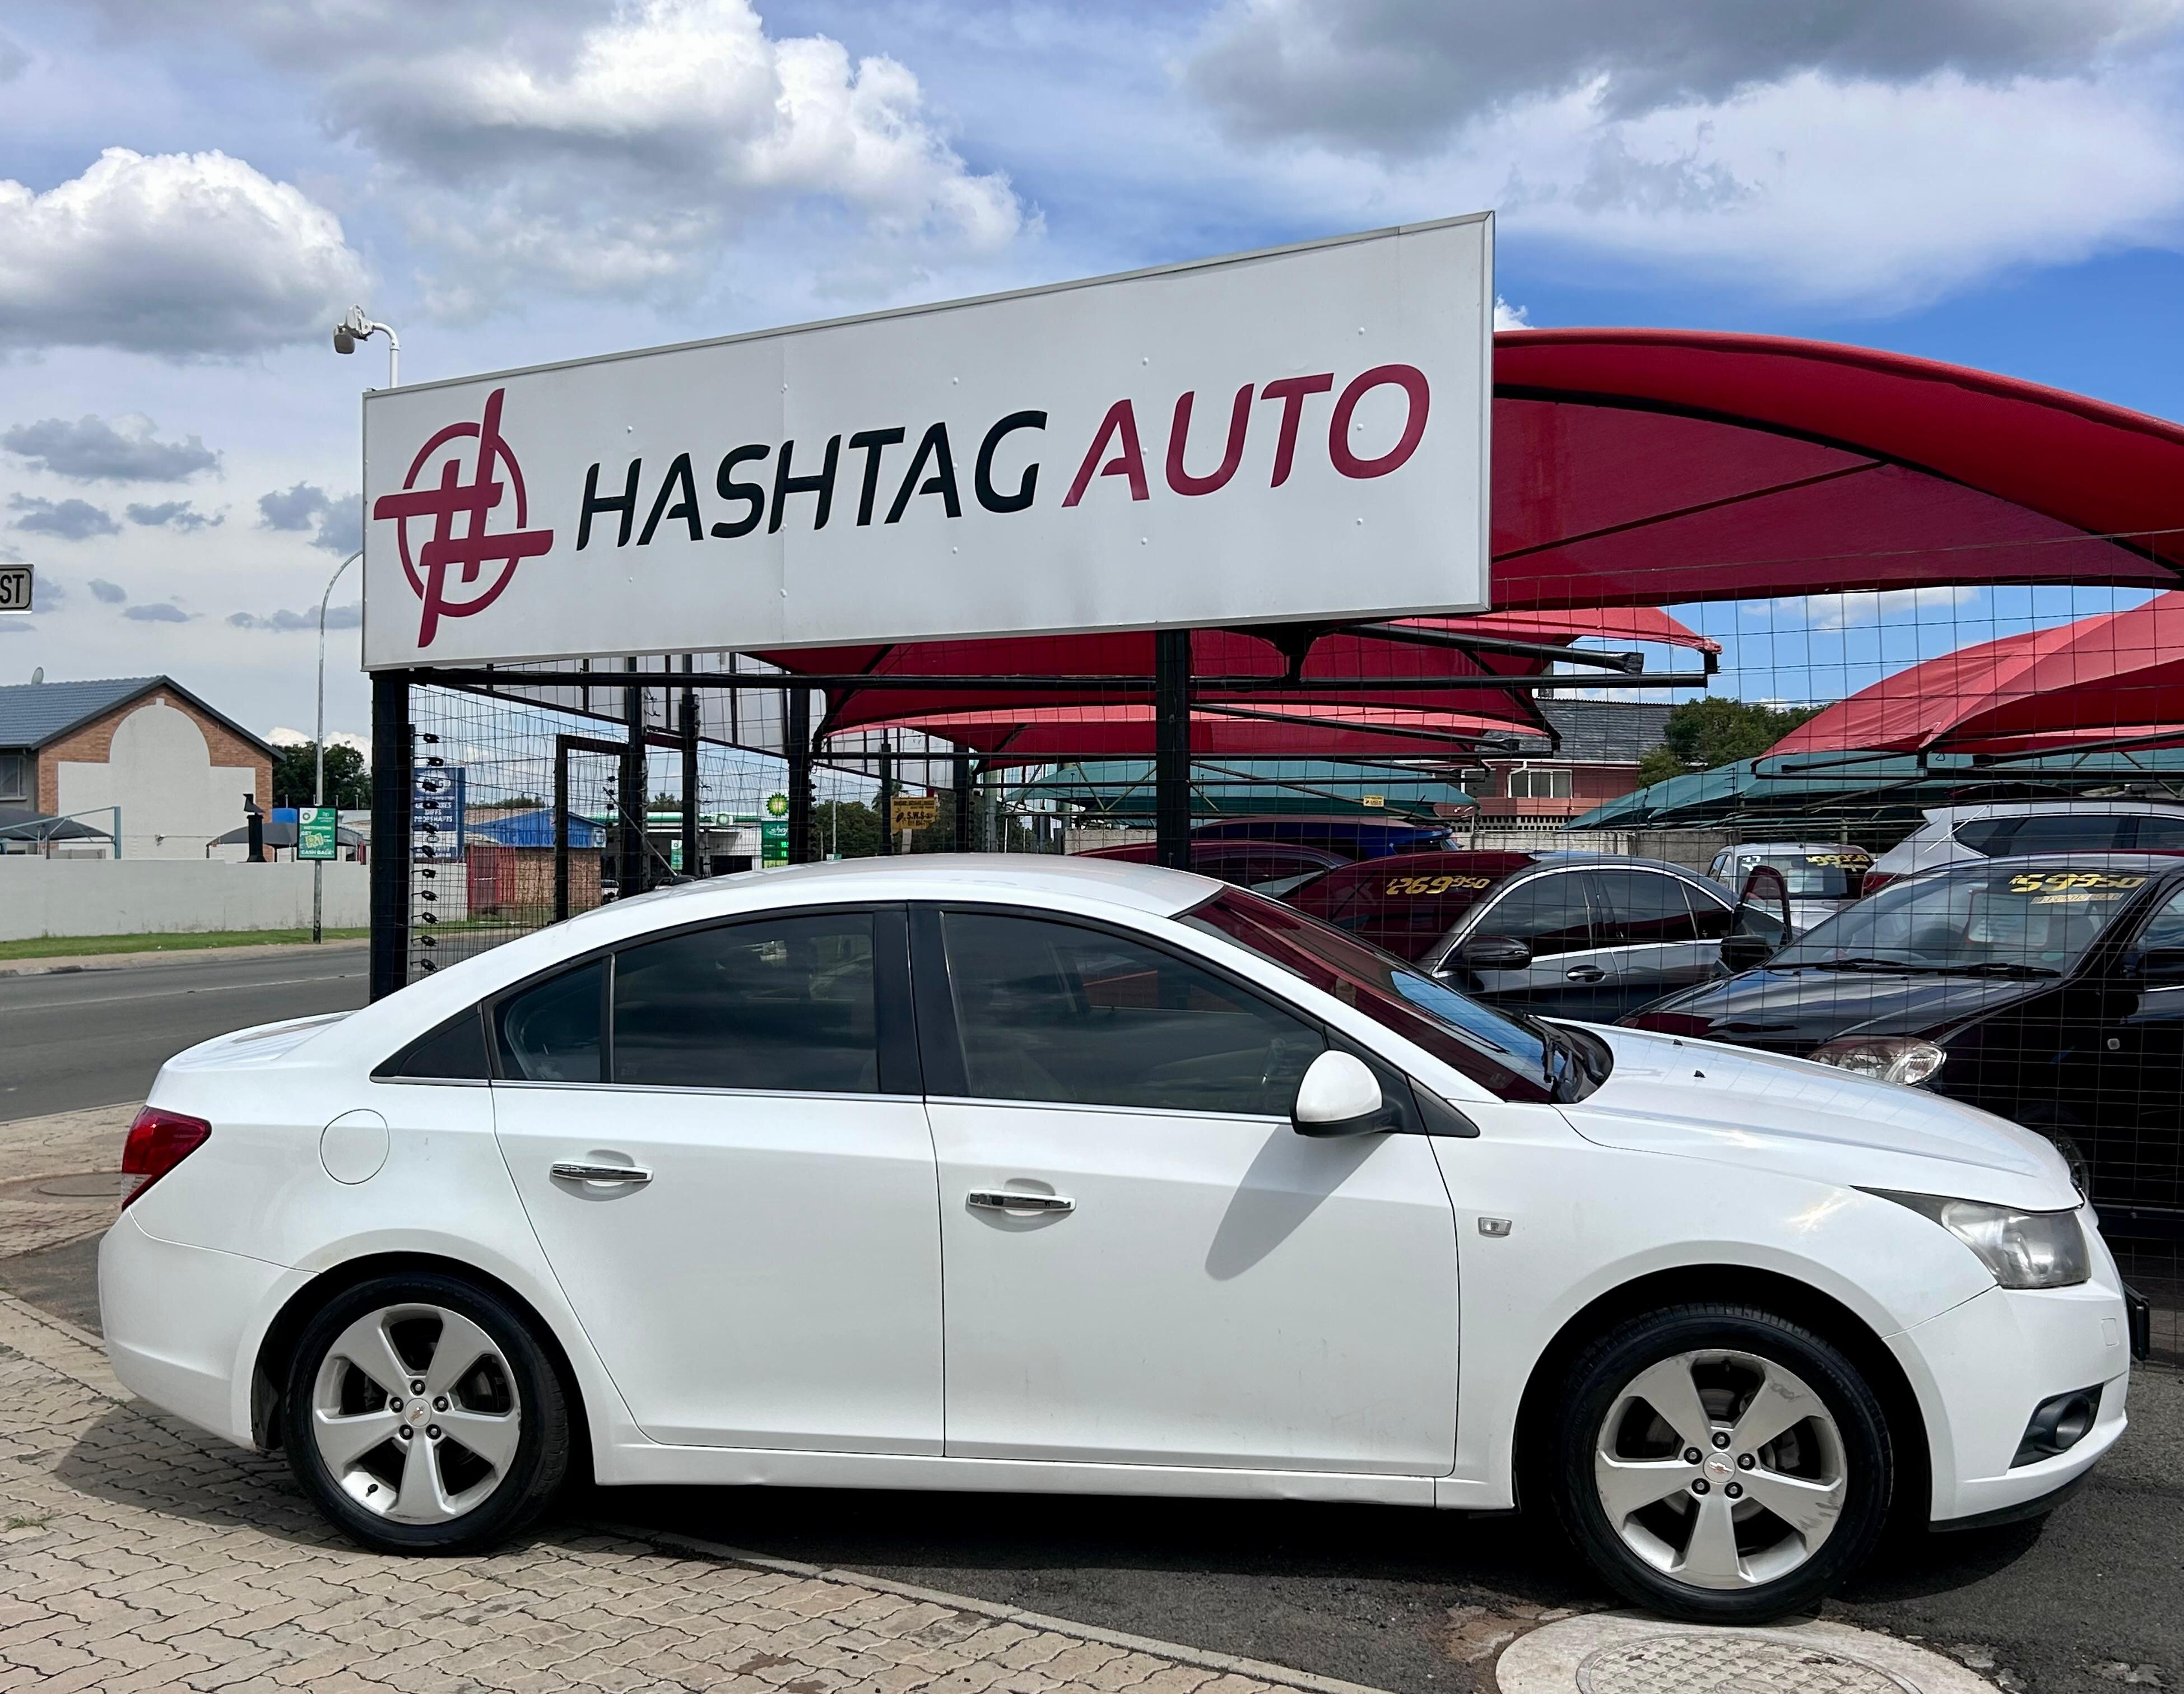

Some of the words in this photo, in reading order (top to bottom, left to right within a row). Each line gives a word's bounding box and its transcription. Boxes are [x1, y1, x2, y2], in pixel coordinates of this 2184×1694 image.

[576, 410, 1048, 552] HASHTAG
[1061, 364, 1430, 508] AUTO
[0, 574, 24, 604] ST
[1386, 875, 1491, 895] R269950
